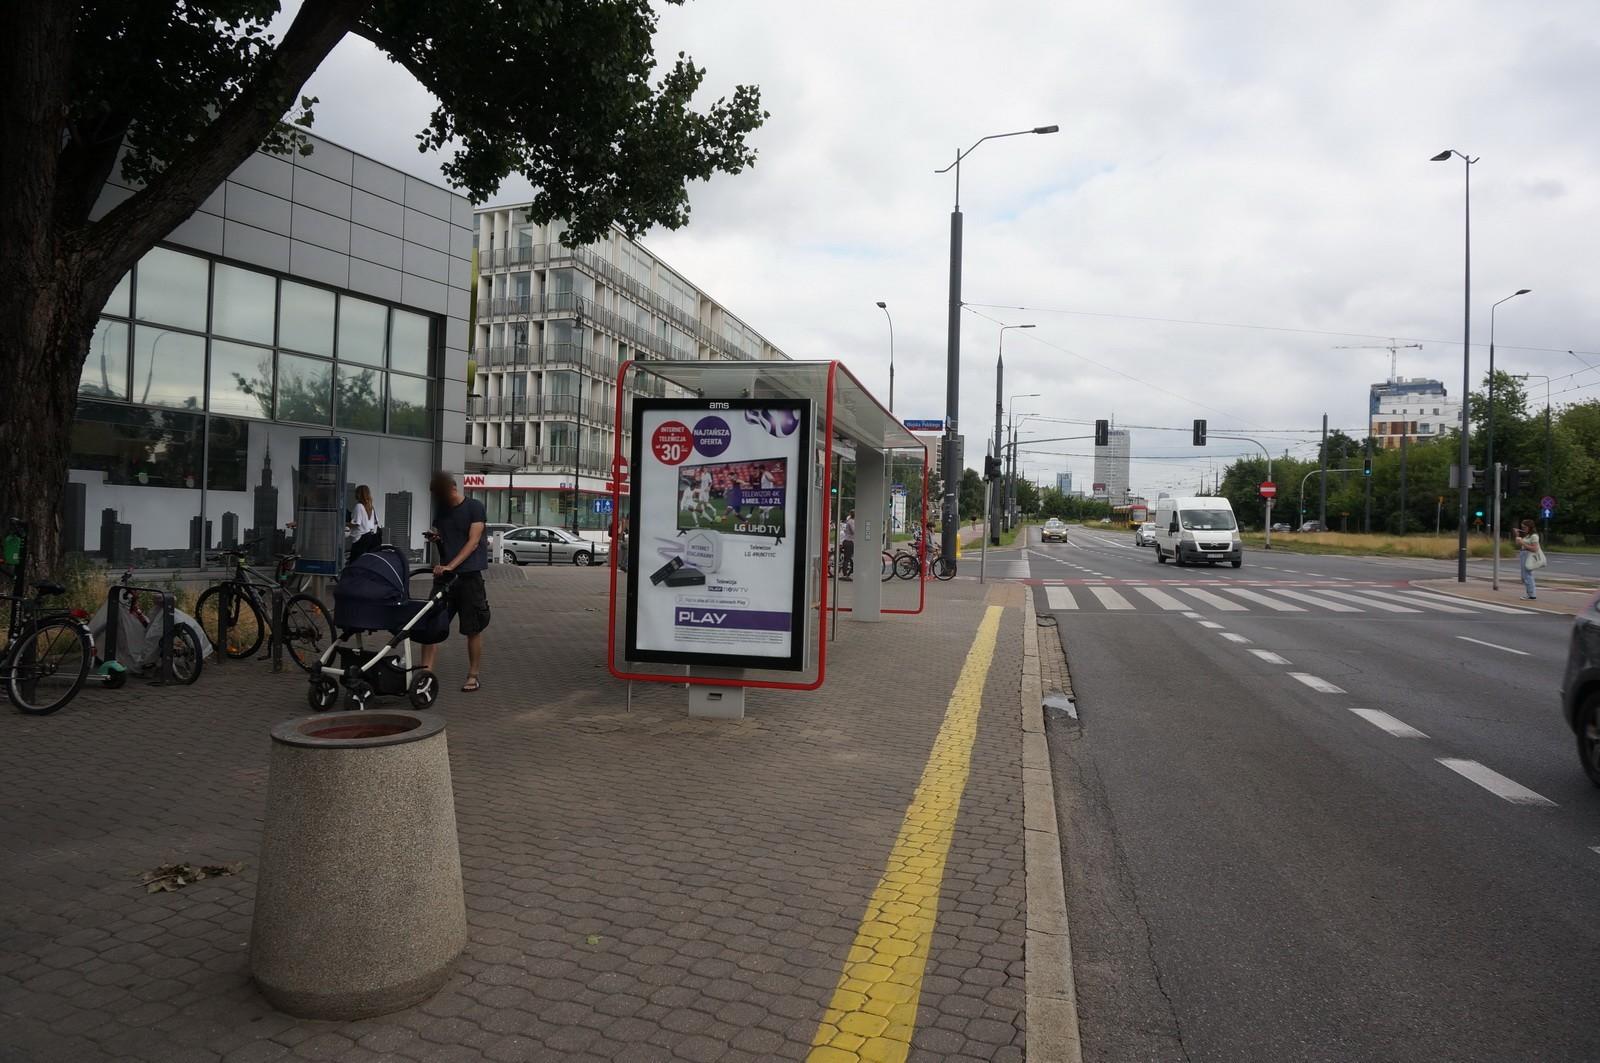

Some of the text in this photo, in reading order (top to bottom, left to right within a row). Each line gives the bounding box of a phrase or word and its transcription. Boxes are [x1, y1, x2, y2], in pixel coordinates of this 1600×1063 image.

[693, 427, 730, 437] NAJTAŃSZA
[661, 444, 681, 461] 30
[464, 476, 485, 486] ANN
[734, 523, 781, 534] LG UHD TV
[678, 611, 727, 624] PLAY
